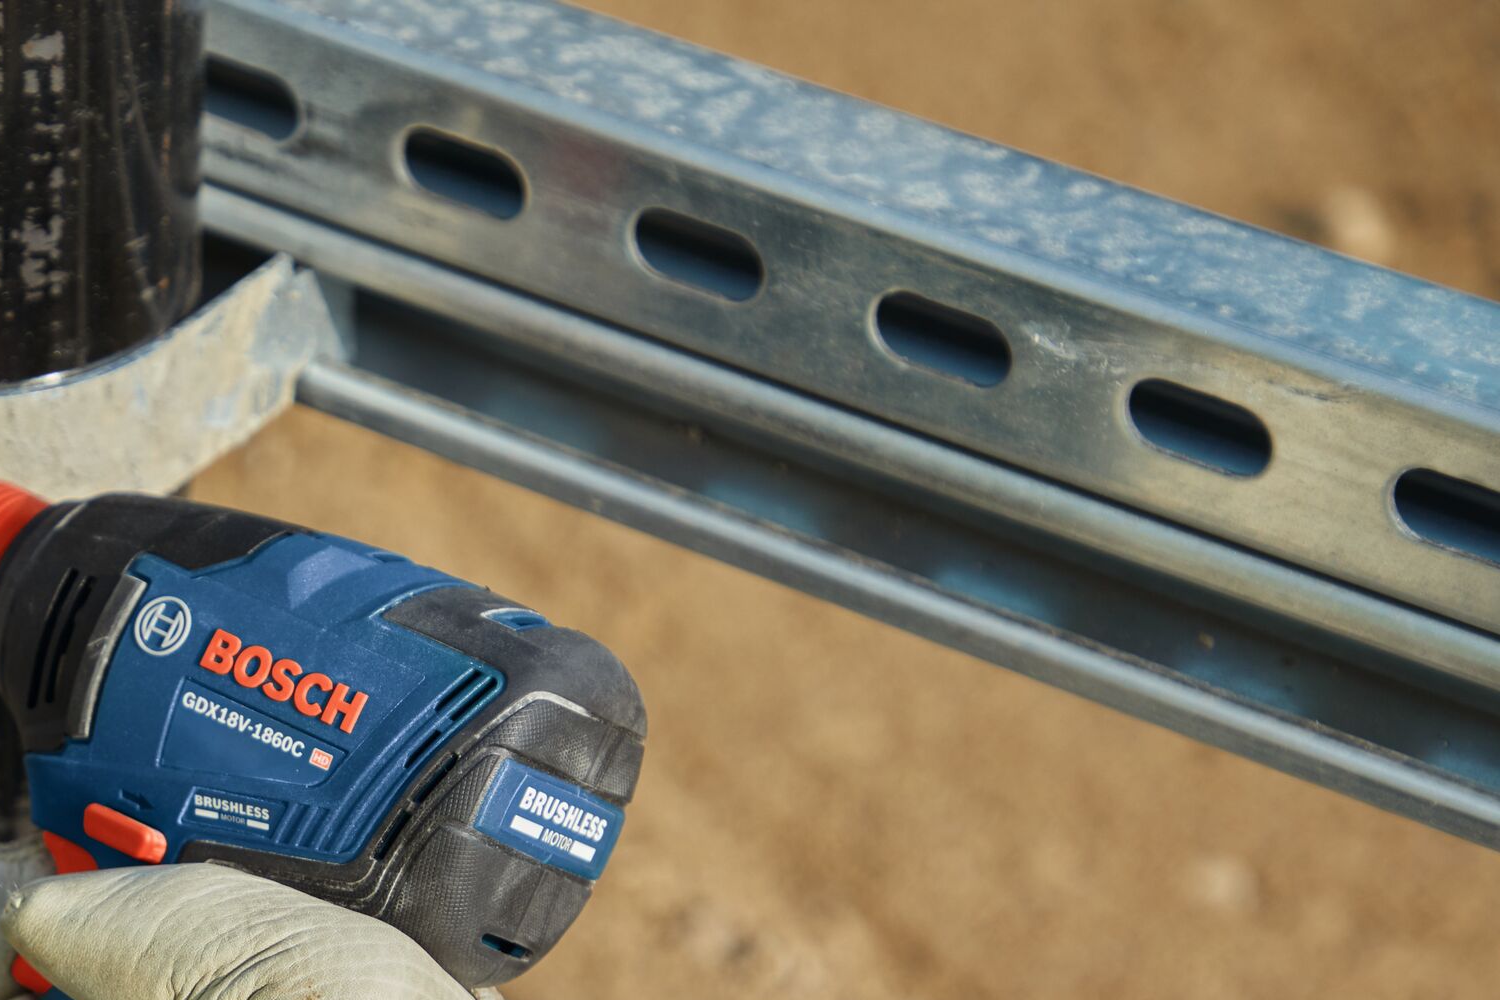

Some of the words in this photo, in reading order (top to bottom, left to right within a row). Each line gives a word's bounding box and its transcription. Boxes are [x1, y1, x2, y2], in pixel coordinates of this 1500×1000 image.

[200, 628, 369, 734] BOSCH
[182, 691, 305, 758] GDX18V-1860C
[194, 794, 270, 820] BRUSHLESS
[220, 813, 246, 825] MOTOR
[519, 786, 608, 842] BRUSHLESS
[541, 828, 573, 852] MOTOR
